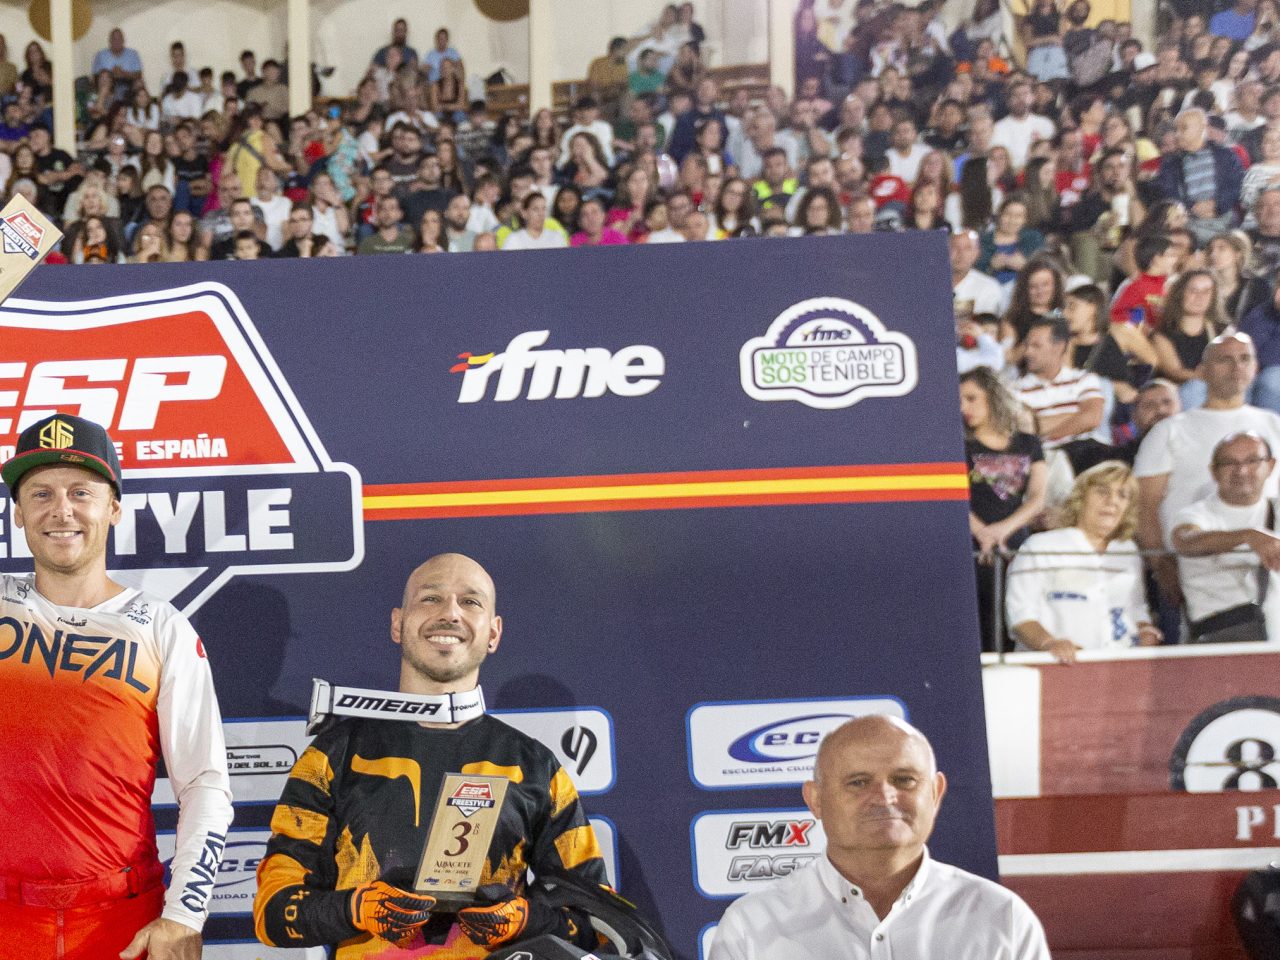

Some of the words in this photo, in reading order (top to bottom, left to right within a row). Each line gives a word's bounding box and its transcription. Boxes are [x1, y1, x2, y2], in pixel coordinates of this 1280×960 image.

[0, 222, 36, 257] FREESTYLE
[13, 215, 42, 240] ESP
[801, 324, 852, 342] rfme
[457, 329, 667, 404] rfme
[760, 351, 807, 366] MOTO
[810, 350, 832, 364] DE
[836, 348, 895, 363] CAMPO
[761, 361, 896, 384] SOSTENIBLE
[136, 433, 229, 461] ESPAÑA
[334, 693, 443, 717] OMEGA
[460, 786, 489, 796] ESP
[451, 799, 491, 808] FREESTYLE
[443, 821, 472, 857] 3
[727, 820, 812, 848] FMX
[434, 860, 472, 869] ALBACETE
